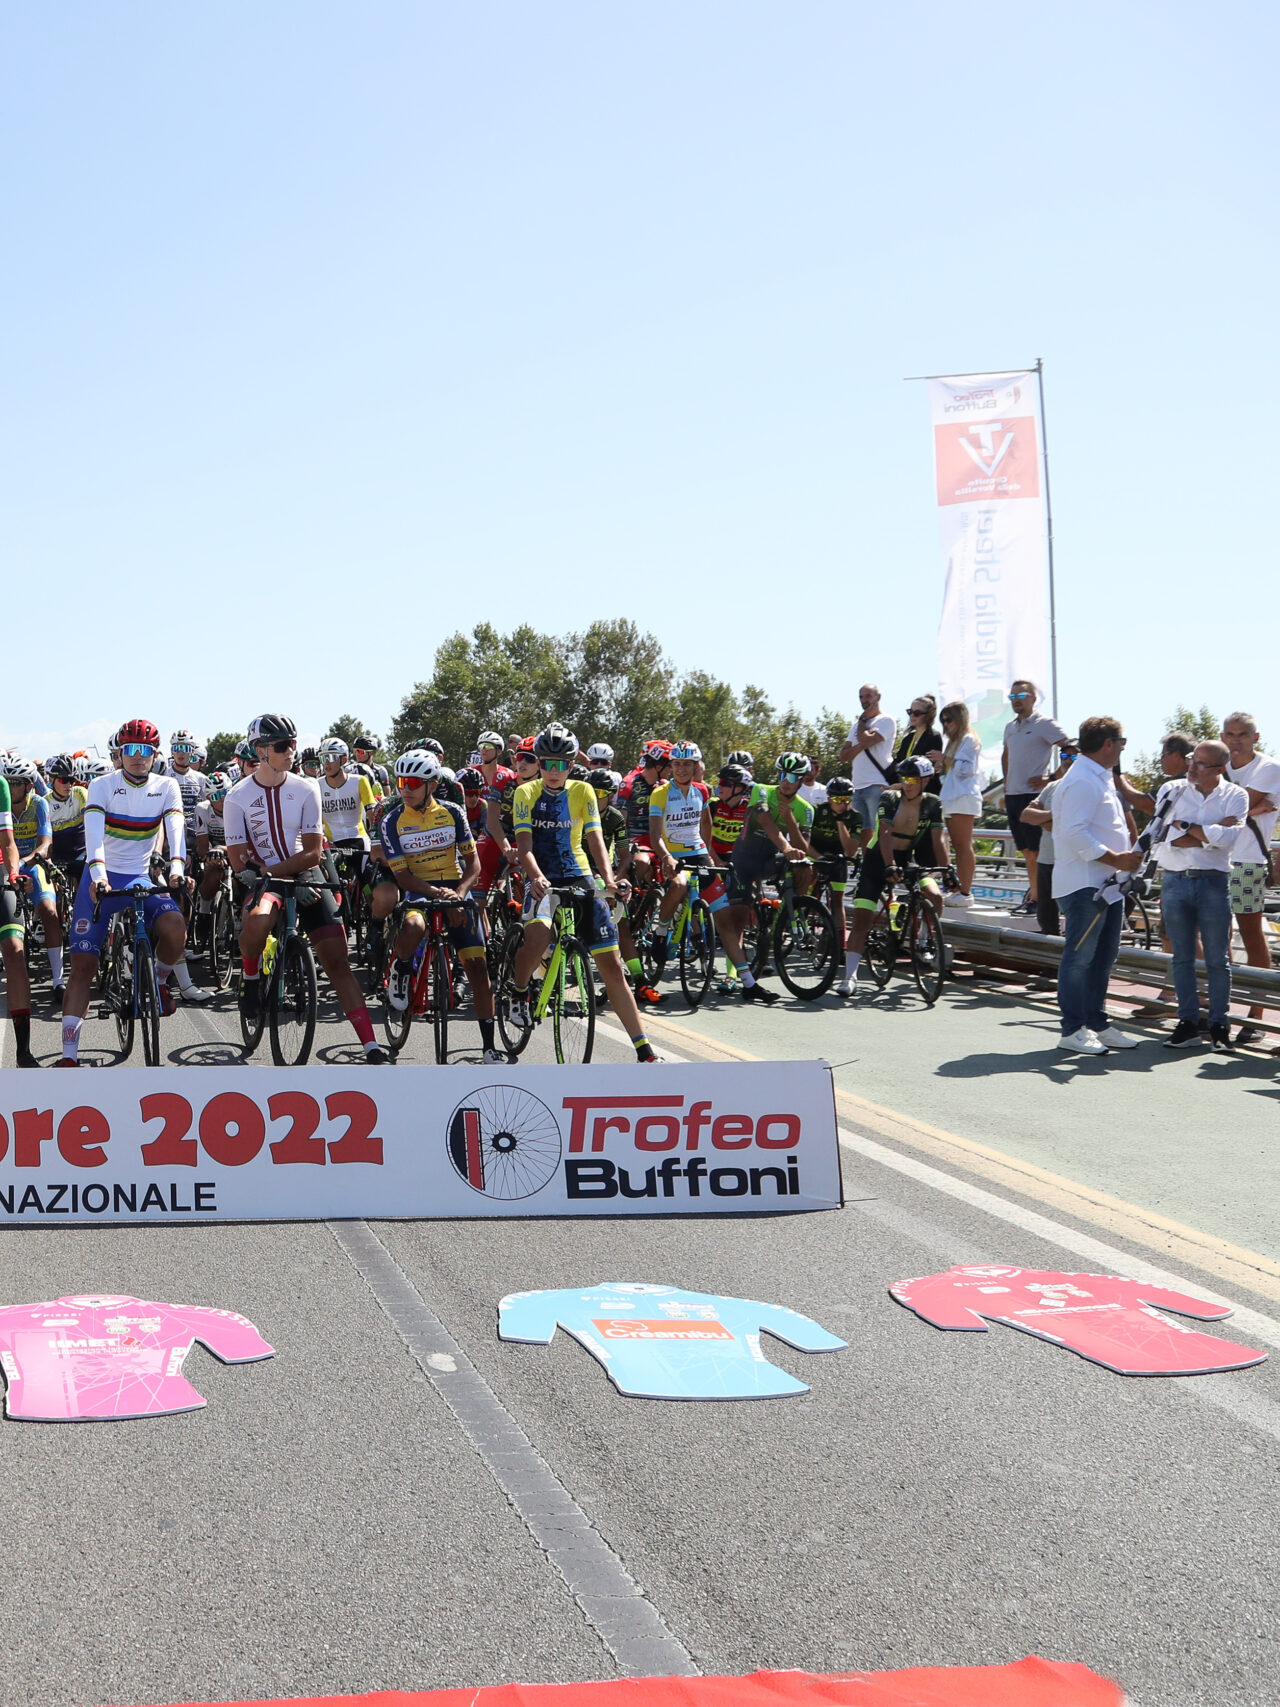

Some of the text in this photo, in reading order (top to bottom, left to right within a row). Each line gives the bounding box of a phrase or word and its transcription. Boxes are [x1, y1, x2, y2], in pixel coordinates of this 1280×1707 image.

[403, 834, 454, 850] COLOMBIA
[414, 832, 444, 842] TALENTOS
[140, 1090, 385, 1167] 2022
[562, 1095, 801, 1152] Trofeo
[564, 1155, 800, 1199] Buffoni
